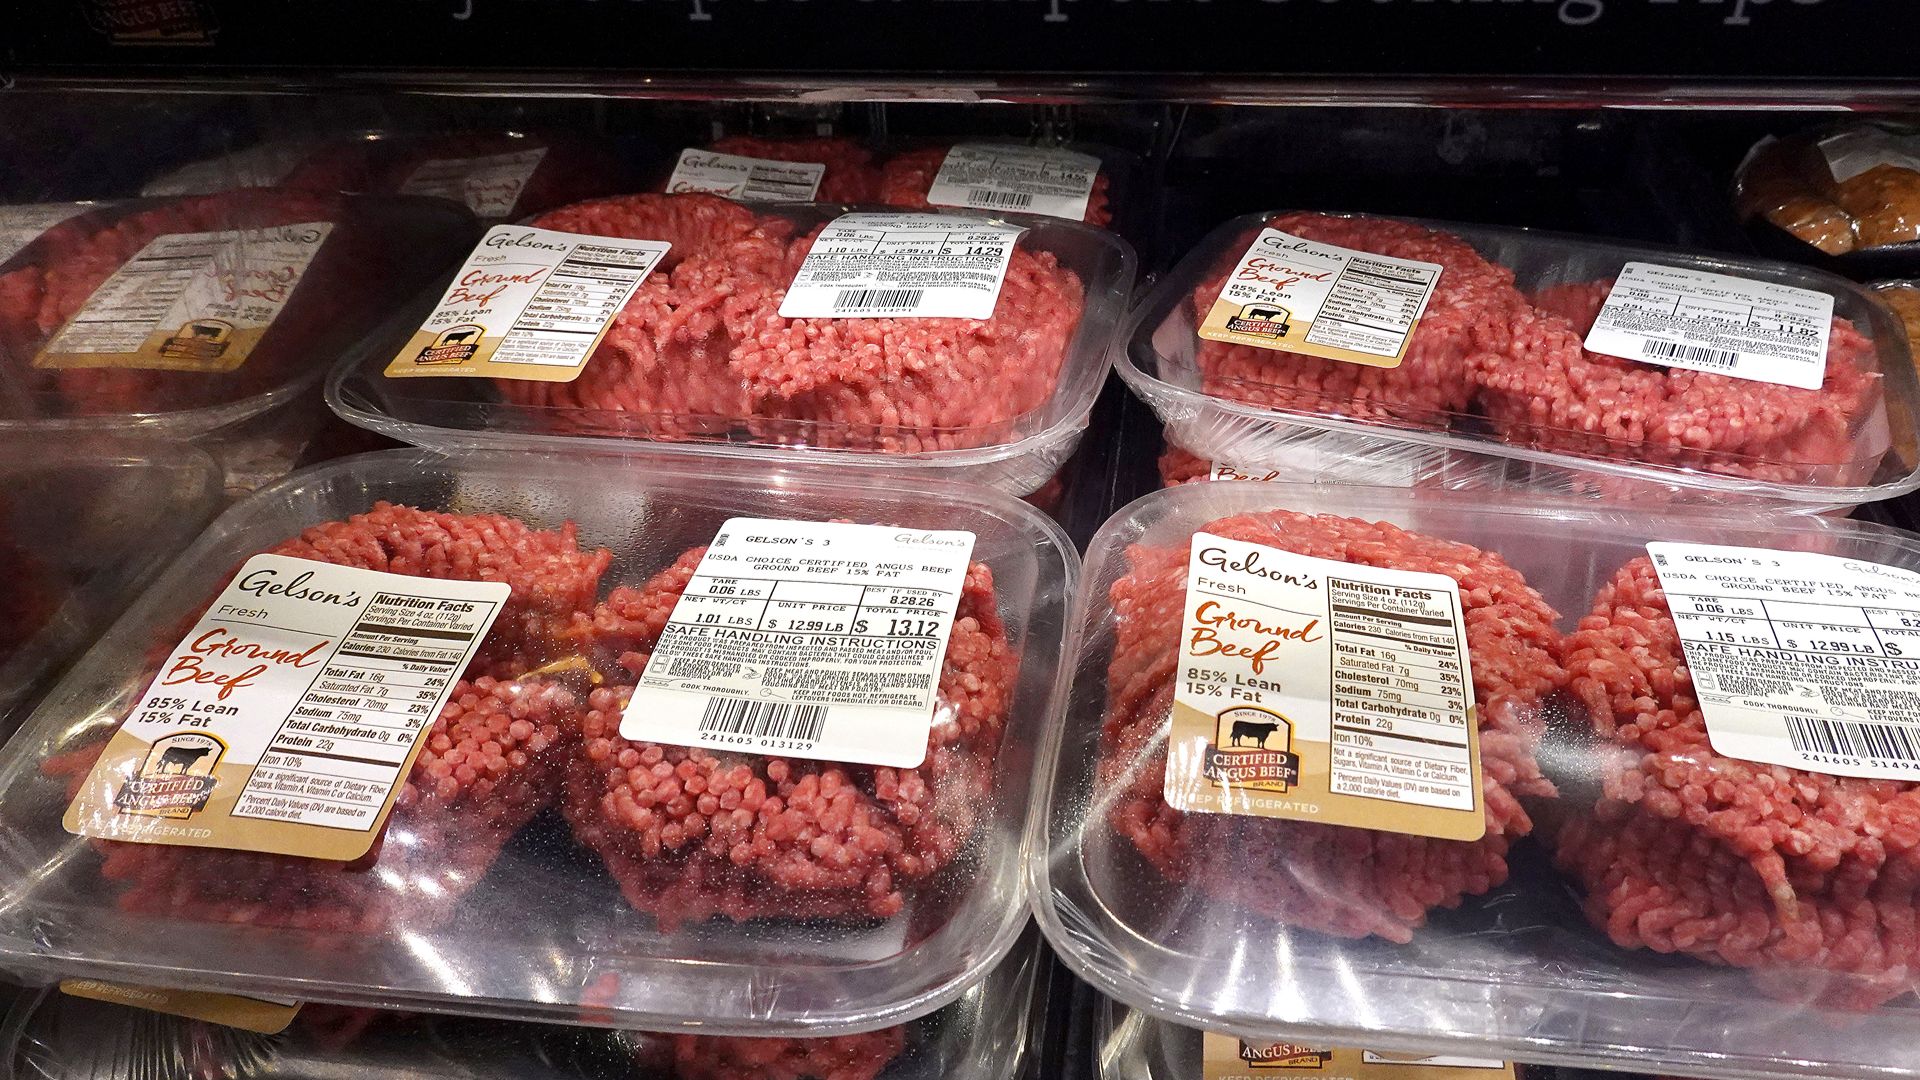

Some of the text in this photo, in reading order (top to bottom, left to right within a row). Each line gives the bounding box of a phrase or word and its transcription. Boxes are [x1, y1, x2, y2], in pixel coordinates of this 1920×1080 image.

[486, 233, 568, 252] Gelson's
[965, 246, 1002, 256] 14.29
[1263, 236, 1342, 260] Gelson's
[1256, 248, 1288, 258] Fresh
[460, 268, 547, 286] Ground
[1237, 267, 1300, 290] Beef
[1248, 258, 1332, 282] Ground
[444, 284, 508, 307] Beef
[1229, 290, 1276, 302] 15% Fat
[1231, 284, 1291, 298] 85% Lean
[430, 316, 451, 325] 15%
[435, 310, 458, 318] 85%
[1780, 324, 1818, 336] 11.82
[745, 536, 813, 544] GELSON'S
[708, 553, 737, 561] USDA
[798, 559, 867, 567] CERTIFIED
[921, 565, 952, 573] BEEF
[1199, 547, 1317, 588] Gelson's
[1684, 555, 1760, 565] GELSON'S
[238, 569, 360, 606] Gelson's
[708, 585, 760, 596] 0.06 LBS
[1198, 576, 1245, 594] Fresh
[1331, 577, 1431, 600] Nutrition Facts
[1705, 575, 1844, 589] CHOICE CERTIFIED
[1721, 582, 1816, 594] GROUND BEEF
[374, 594, 474, 612] Nutrition Facts
[778, 600, 846, 611] UNIT PRICE
[889, 595, 934, 606] 8.28.26
[1694, 603, 1753, 615] 0.06 LBS
[217, 604, 267, 618] Fresh
[368, 605, 398, 616] Serving
[398, 608, 415, 617] Size
[435, 612, 461, 622] (112g)
[695, 613, 752, 625] 1.01 LBS
[906, 609, 939, 617] PRICE
[362, 613, 474, 630] Servings Per Container Varied
[767, 619, 843, 632] $ 12.99 LB
[854, 619, 939, 639] $ 13.12
[1195, 601, 1322, 642] Ground
[666, 625, 936, 650] SAFE HANDLING INSTRUCTIONS
[1706, 631, 1769, 644] 1.15 LBS
[190, 628, 328, 667] Ground
[342, 641, 391, 653] Calories 230
[1190, 627, 1280, 675] Beef
[1684, 642, 1840, 665] SAFE HANDLING
[1810, 640, 1874, 653] 12.99 LB
[1334, 642, 1458, 670] Total Fat 16g 24%
[162, 655, 267, 700] Beef
[324, 667, 444, 686] Total Fat 16g 24%
[1340, 656, 1460, 683] Saturated Fat 7g 35%
[1187, 668, 1280, 692] 85% Lean
[1334, 670, 1418, 691] Cholesterol 70mg
[1186, 682, 1261, 703] 15% Fat
[147, 697, 238, 715] 85% Lean
[305, 693, 428, 714] Cholesterol 70mg 23%
[138, 711, 211, 727] 15% Fat
[295, 706, 420, 728] Sodium 75mg 3%
[1335, 712, 1392, 730] Protein 22g
[286, 719, 412, 743] Total Carbohydrate 0g 0%
[275, 734, 334, 751] Protein 22g
[700, 732, 812, 750] 241605 013129
[262, 753, 302, 767] Iron 10%
[1213, 754, 1287, 765] CERTIFIED
[1355, 751, 1387, 763] significant
[1390, 757, 1412, 766] source
[1424, 761, 1447, 773] Dietary
[1802, 753, 1860, 766] 241605
[1206, 766, 1256, 778] ANGUS
[1242, 1044, 1290, 1058] ANGUS
[1288, 1056, 1318, 1065] BRAND
